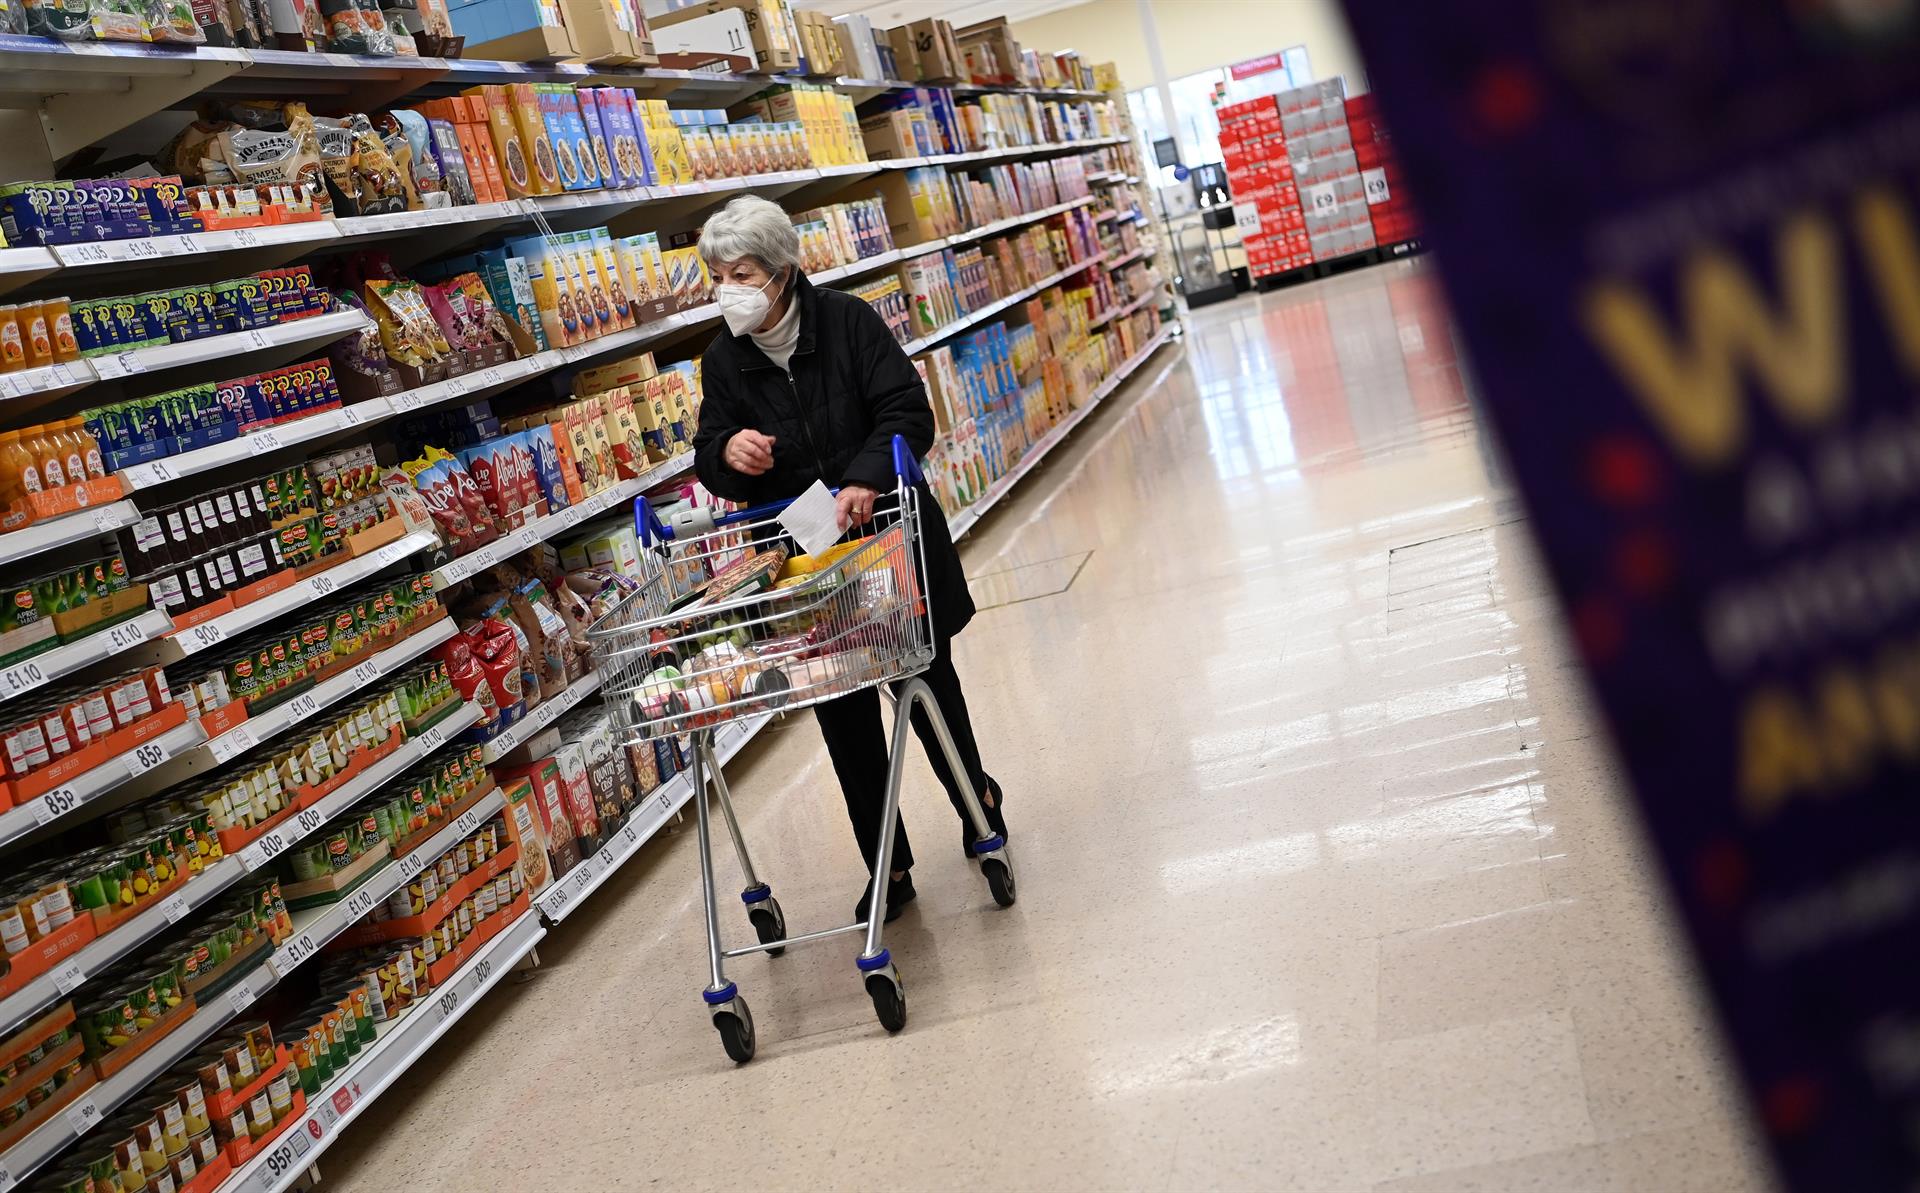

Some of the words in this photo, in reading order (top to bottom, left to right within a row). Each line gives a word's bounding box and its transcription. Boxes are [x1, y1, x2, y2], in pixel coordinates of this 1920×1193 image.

[246, 166, 282, 183] SIMPLY
[1368, 179, 1386, 194] £9
[1316, 192, 1334, 208] £9
[78, 244, 107, 262] £1.35
[129, 242, 158, 256] £1.35
[181, 236, 198, 251] £1
[251, 330, 267, 347] £1
[344, 409, 360, 424] £1
[253, 433, 279, 451] £1.35
[152, 464, 170, 480] £1
[494, 454, 516, 493] Alpen
[511, 448, 535, 482] Alpen
[476, 553, 495, 566] £3.50
[449, 564, 469, 579] £3.30
[312, 577, 333, 595] 90p
[111, 623, 142, 648] £1.10
[195, 624, 220, 645] 90p
[6, 662, 42, 690] £1.10
[356, 661, 379, 682] £1.10
[564, 687, 580, 705] £2.10
[291, 695, 317, 717] £1.10
[421, 728, 443, 749] £1.10
[497, 732, 516, 751] £1.39
[136, 744, 163, 769] 85p
[593, 761, 616, 787] COUNTRY
[600, 776, 613, 792] CRISP
[44, 787, 76, 816] 85p
[660, 794, 672, 808] £3
[299, 811, 320, 832] 80p
[457, 812, 477, 834] £1.10
[625, 827, 637, 842] £3
[259, 832, 284, 858] 80p
[600, 848, 614, 865] £3
[400, 855, 421, 878] £1.10
[575, 867, 592, 887] £1.50
[349, 891, 372, 917] £1.10
[550, 890, 568, 909] £1.50
[290, 935, 314, 963] £1.10
[475, 961, 491, 983] 80p
[440, 992, 458, 1016] 80p
[82, 1104, 96, 1119] 90p
[266, 1146, 293, 1177] 95p
